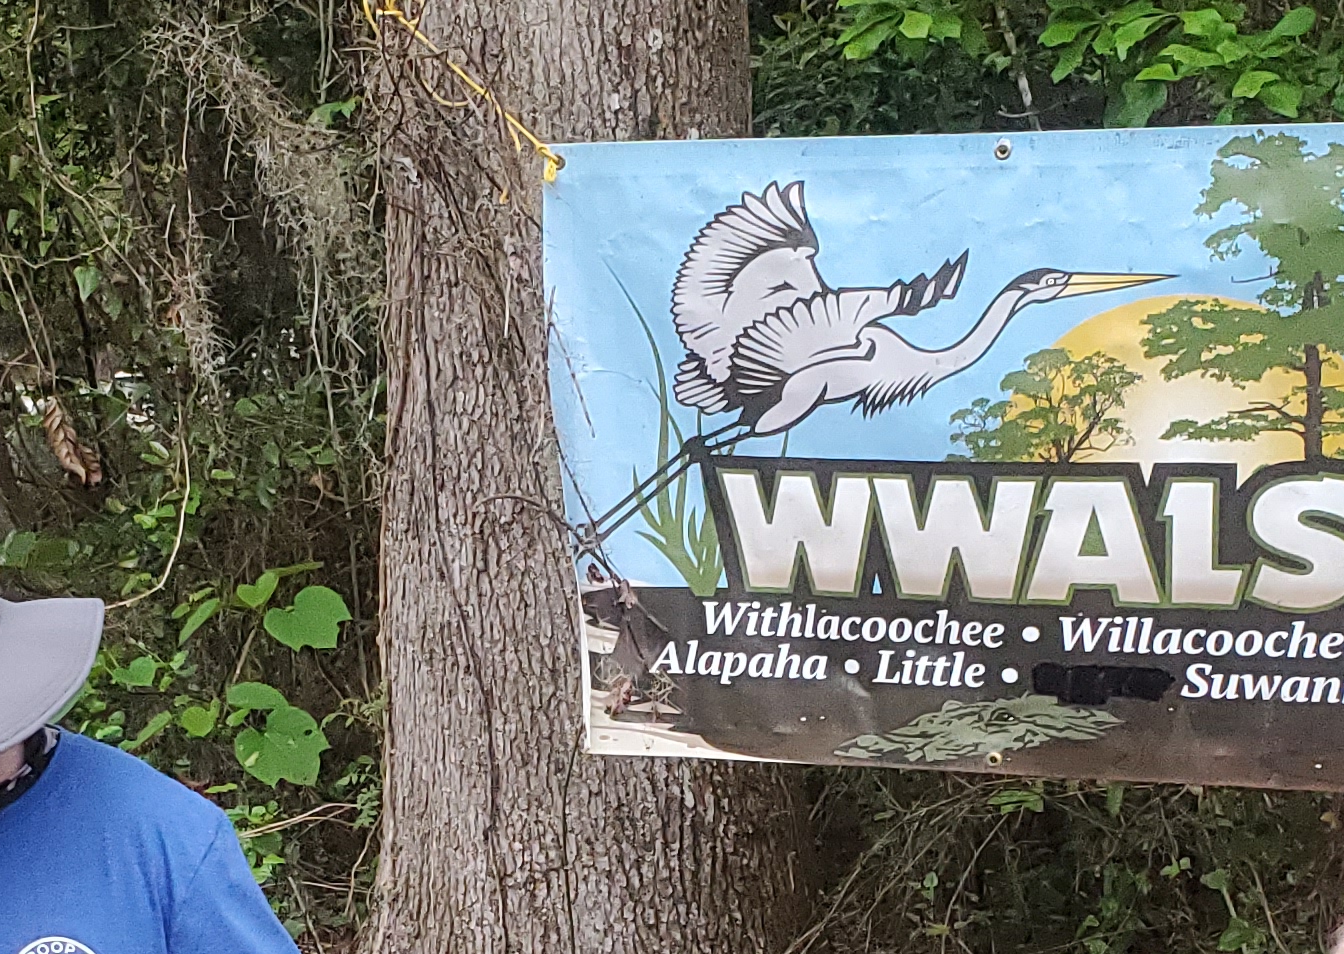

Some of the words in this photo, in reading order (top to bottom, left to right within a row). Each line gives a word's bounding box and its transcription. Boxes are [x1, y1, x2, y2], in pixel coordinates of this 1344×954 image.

[703, 601, 1005, 648] Withlacoochee
[650, 640, 827, 684] Alapaha
[872, 649, 987, 688] Little
